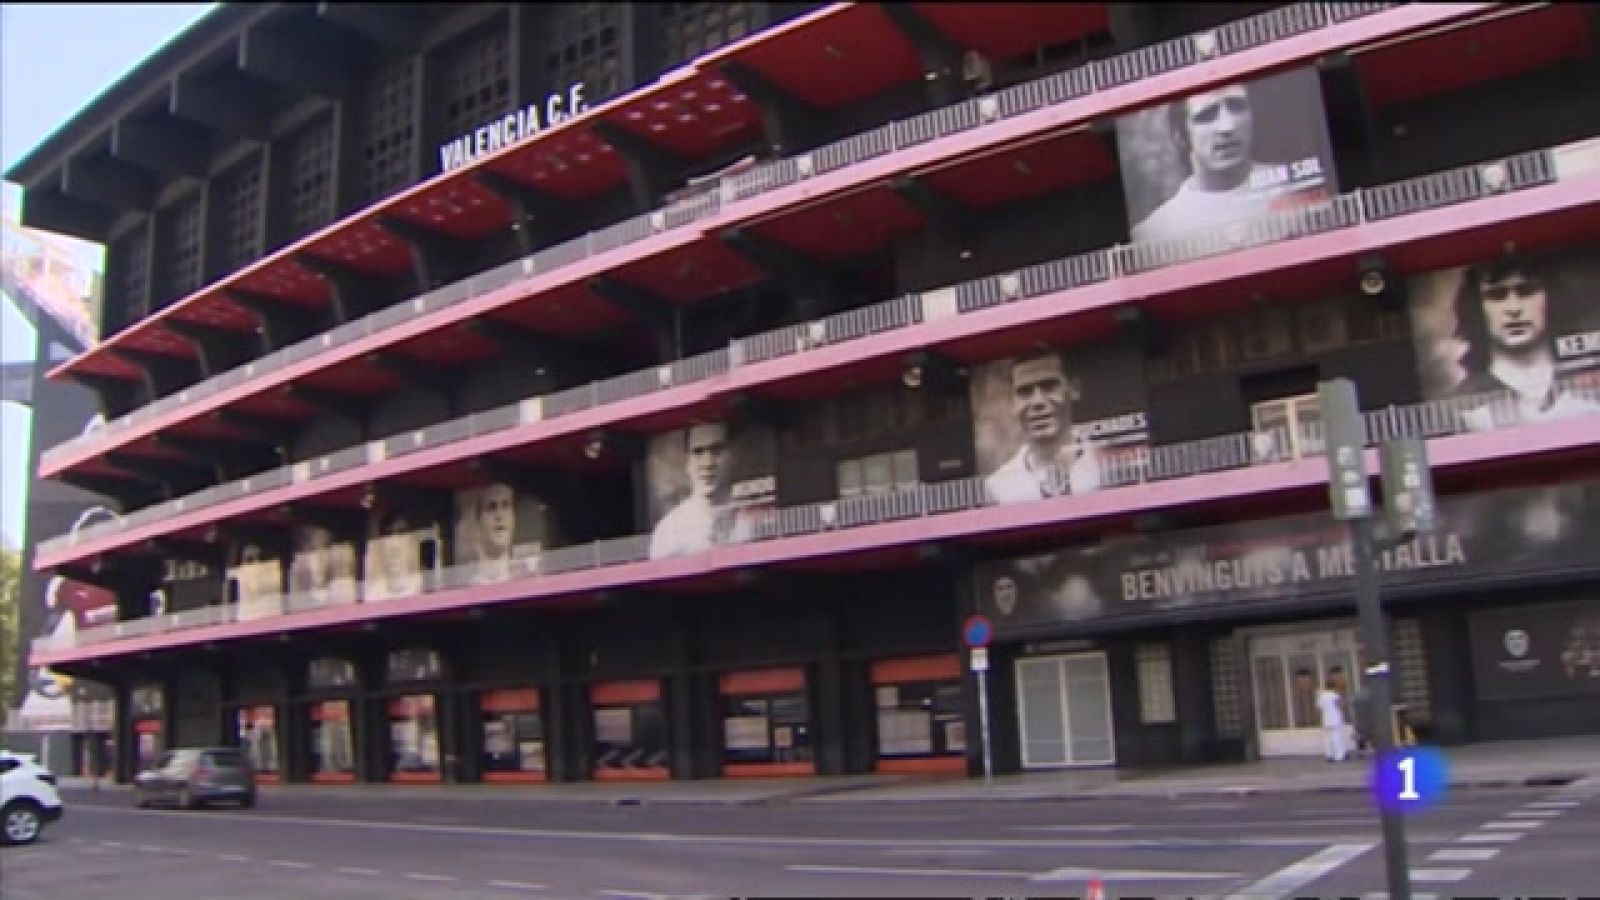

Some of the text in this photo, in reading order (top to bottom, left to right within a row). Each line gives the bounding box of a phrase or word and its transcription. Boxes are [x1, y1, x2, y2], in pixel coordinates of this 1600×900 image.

[440, 82, 589, 173] VALENCIA C.F.
[1291, 156, 1323, 179] SOL
[1293, 551, 1311, 581] A
[1316, 533, 1465, 579] METALLA
